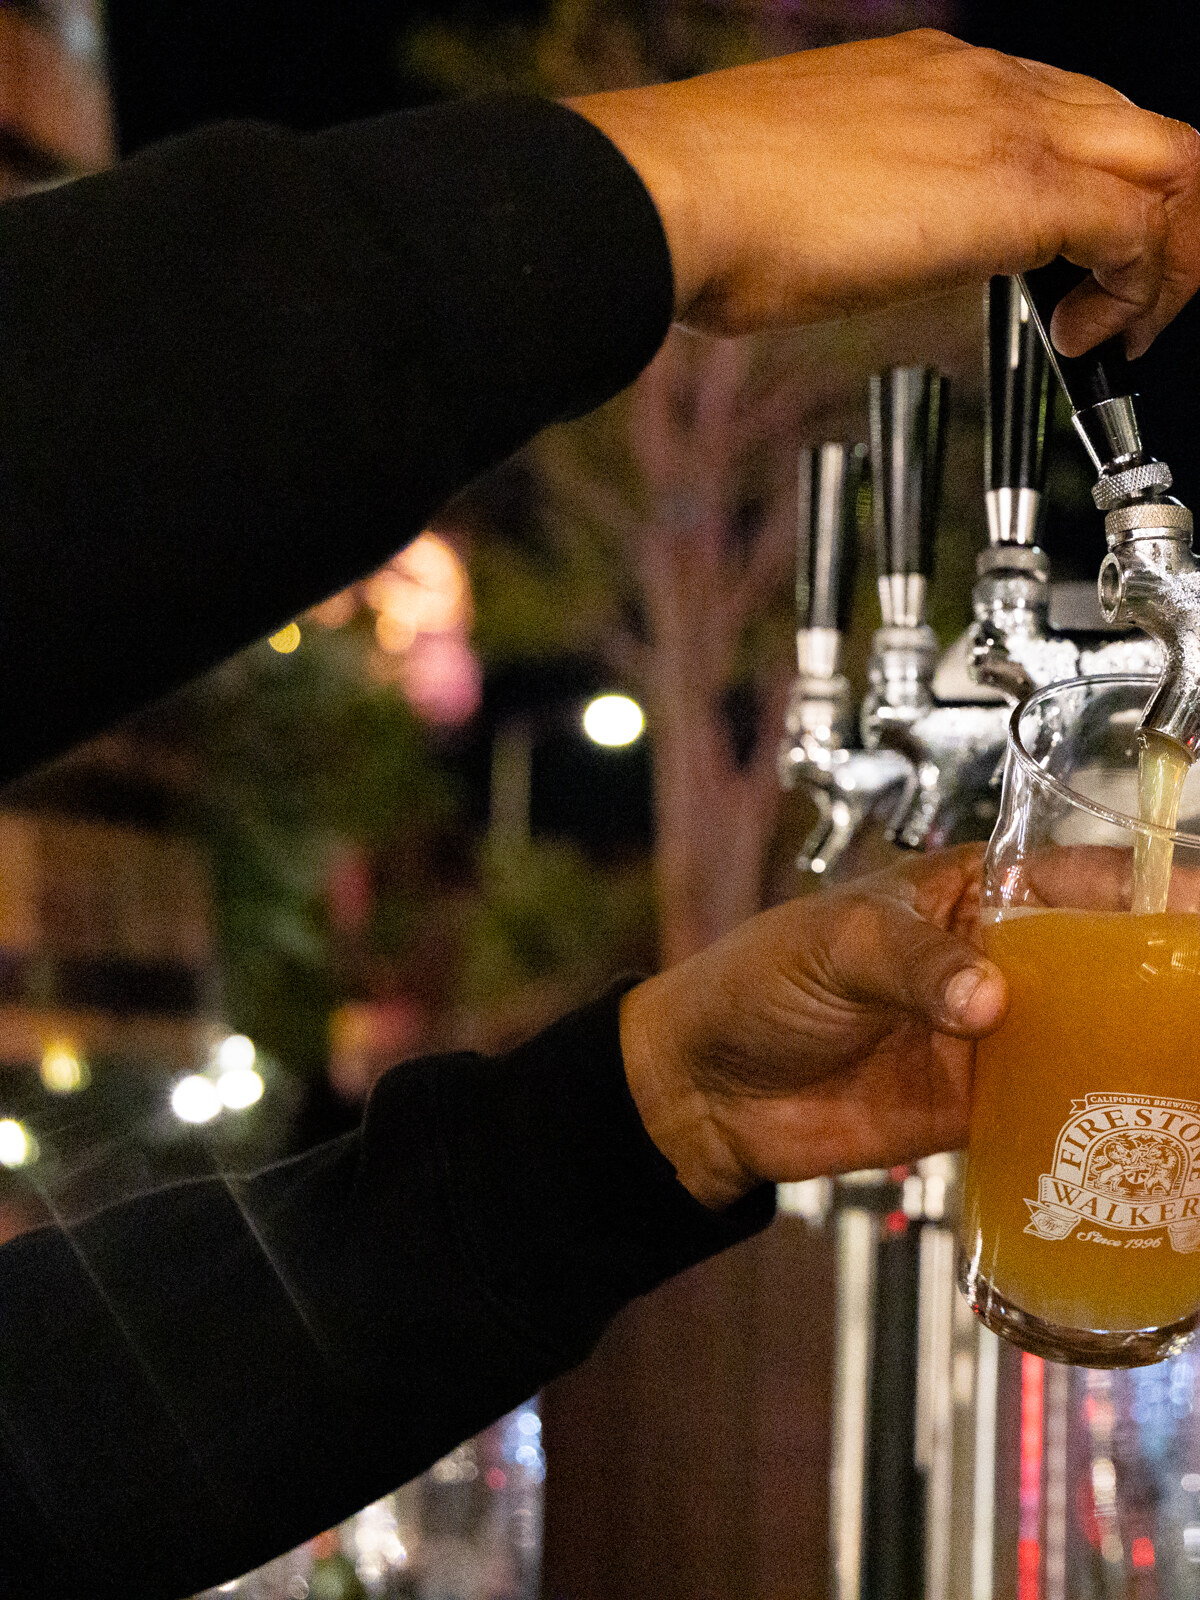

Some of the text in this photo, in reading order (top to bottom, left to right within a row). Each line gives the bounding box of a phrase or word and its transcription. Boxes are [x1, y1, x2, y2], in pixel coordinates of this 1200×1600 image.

[1090, 1096, 1151, 1105] CALIFORNIA
[1154, 1100, 1199, 1111] BREWING
[1052, 1181, 1200, 1226] WALKER
[1077, 1231, 1163, 1248] Since 1996
